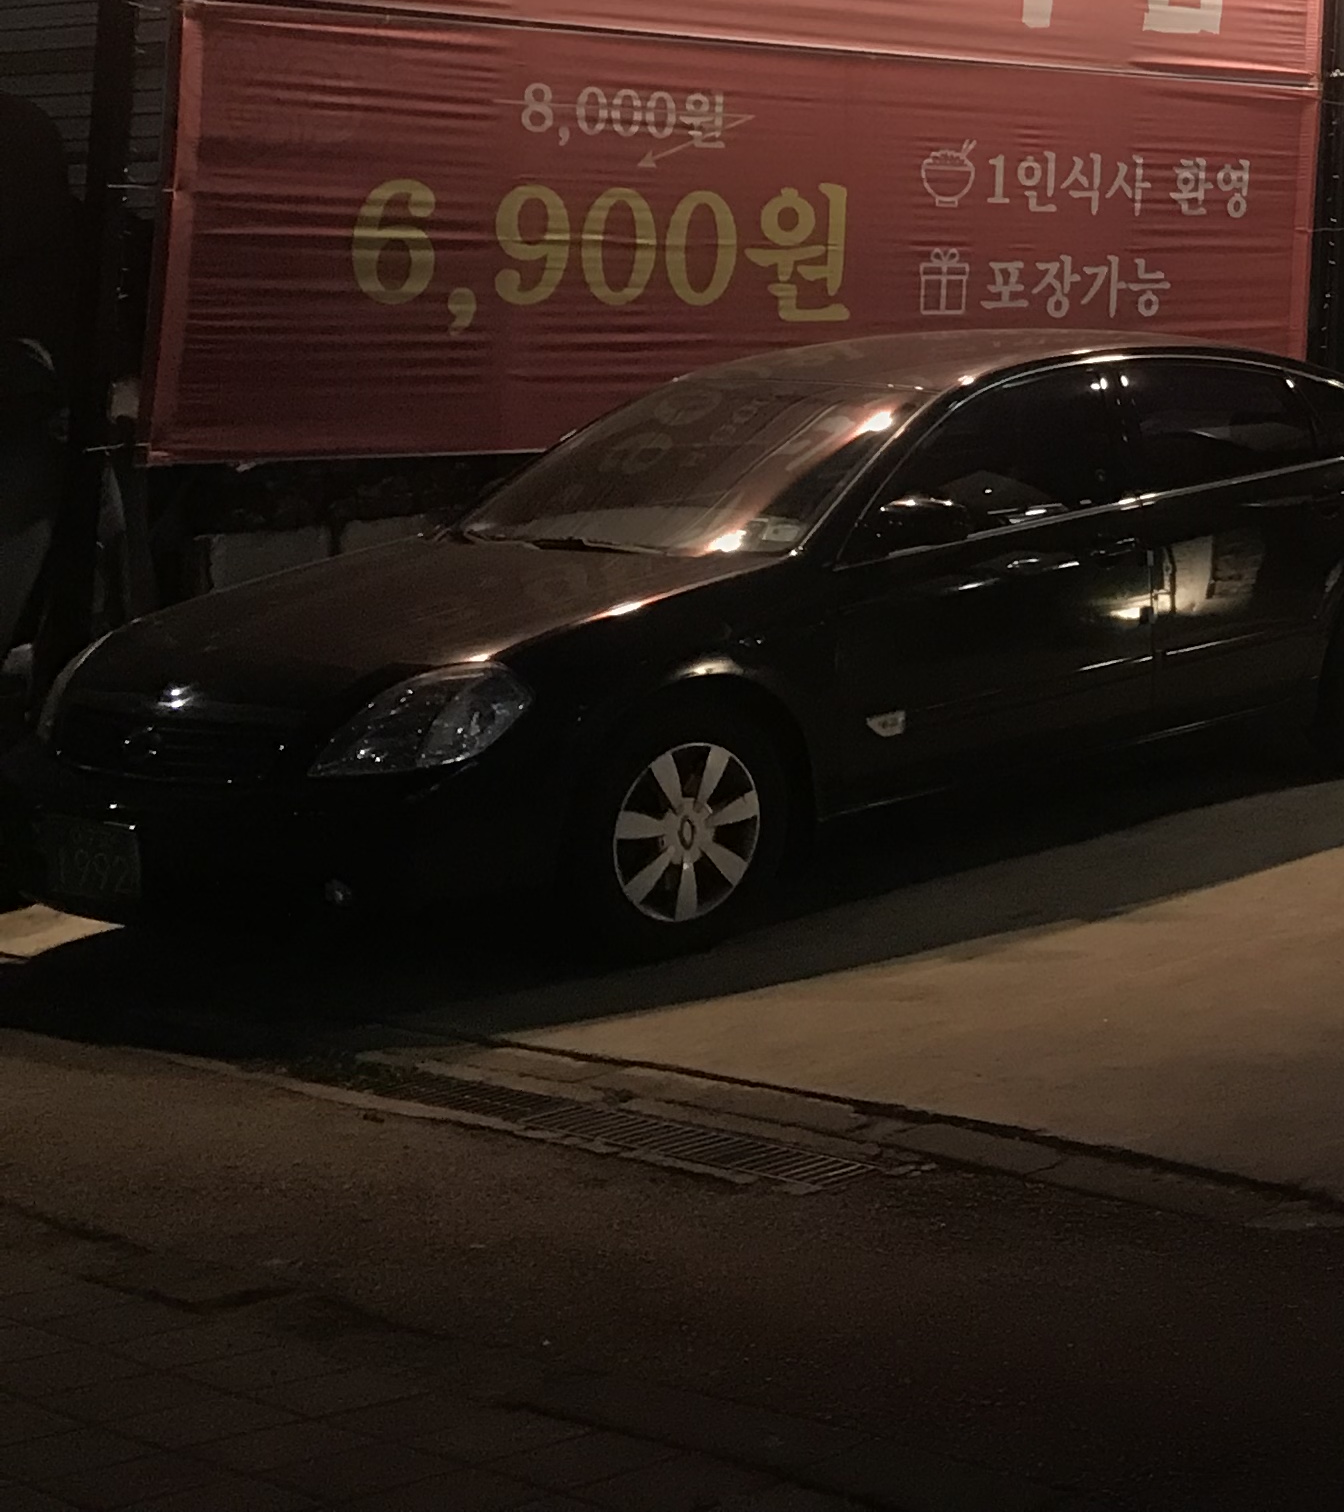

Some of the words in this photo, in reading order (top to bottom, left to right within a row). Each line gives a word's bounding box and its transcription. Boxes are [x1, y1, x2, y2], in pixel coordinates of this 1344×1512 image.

[519, 80, 727, 149] 8,000원
[986, 154, 1152, 219] 1인식사
[1168, 156, 1253, 220] 환영
[350, 178, 853, 335] 6,900원
[980, 252, 1173, 322] 포장가능
